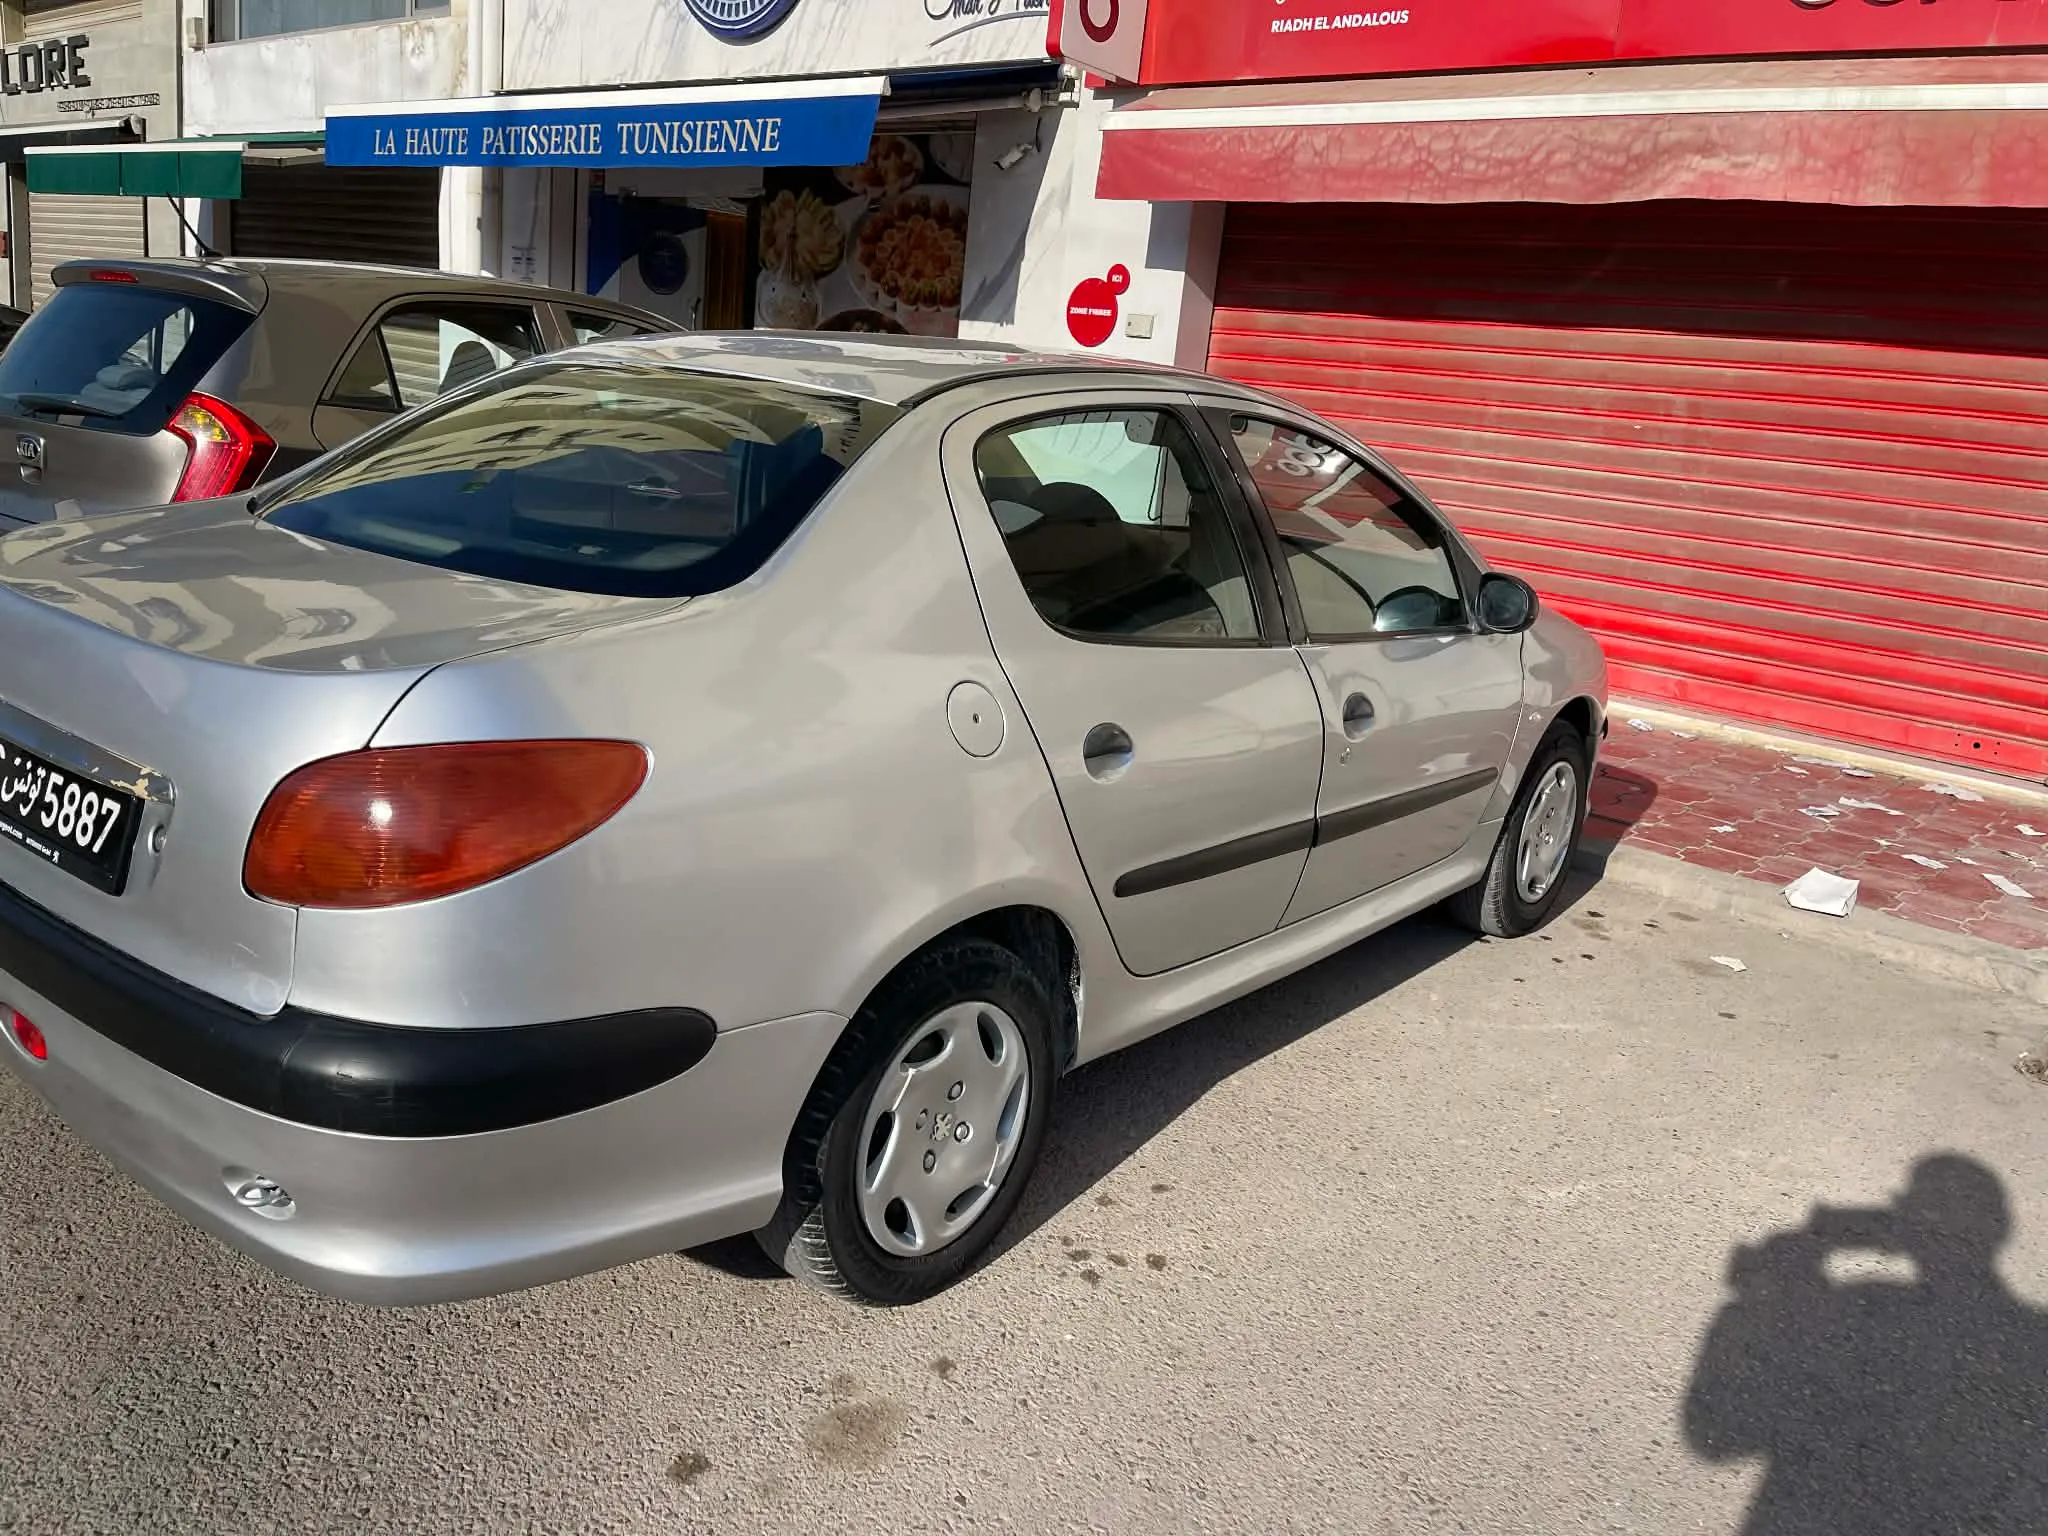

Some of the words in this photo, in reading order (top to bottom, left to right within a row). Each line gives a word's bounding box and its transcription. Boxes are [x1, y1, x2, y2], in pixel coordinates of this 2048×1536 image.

[1271, 18, 1313, 33] RIADH
[1314, 17, 1330, 30] EL
[1331, 10, 1410, 29] ANDALOUS
[374, 129, 397, 155] LA
[404, 127, 469, 156] HAUTE
[480, 124, 603, 156] PATISSERIE
[617, 118, 782, 155] TUNISIENNE
[1069, 306, 1088, 315] ZONE
[1, 757, 46, 816] تونس
[41, 772, 121, 853] 5887
